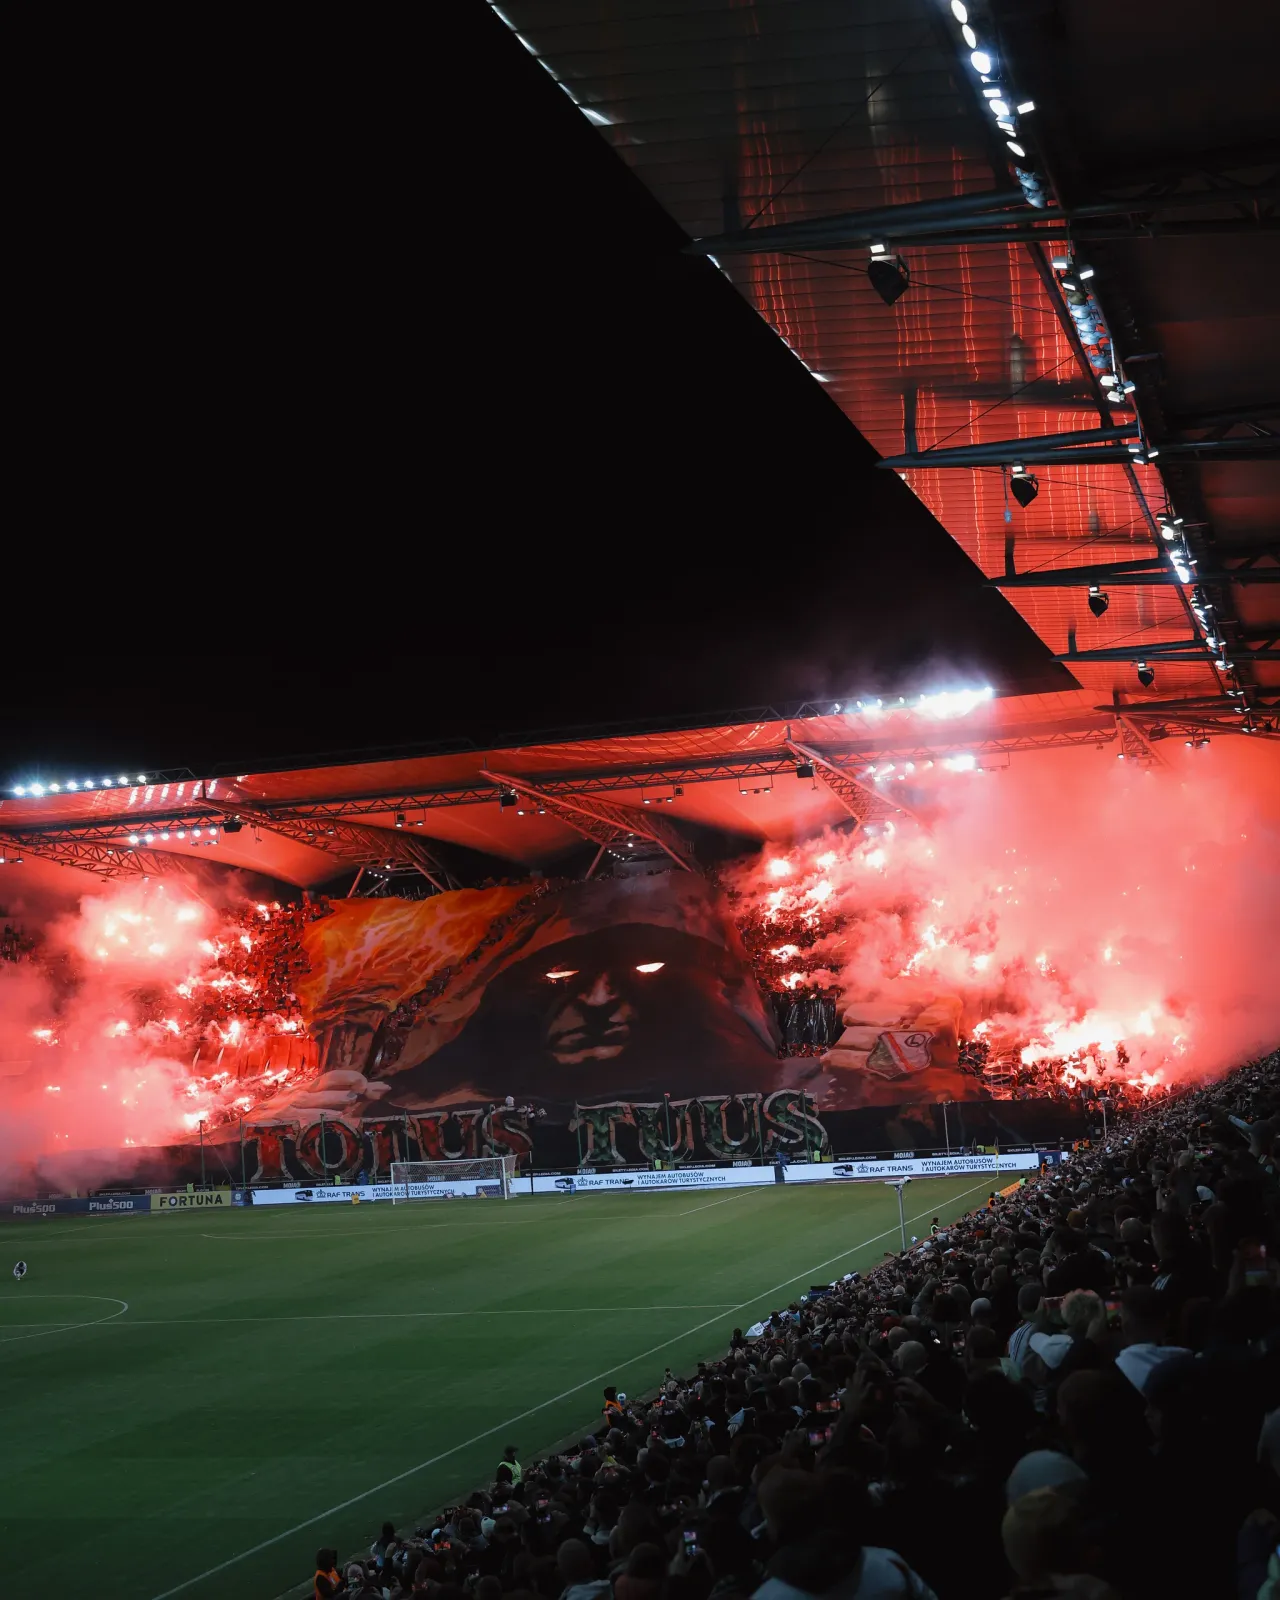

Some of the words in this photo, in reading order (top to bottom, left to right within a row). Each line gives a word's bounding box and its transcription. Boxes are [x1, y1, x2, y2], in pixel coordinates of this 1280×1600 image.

[242, 1105, 532, 1181] TOTUS
[568, 1088, 827, 1166] TUUS
[953, 1157, 993, 1165] AUTOBUSÓW
[925, 1164, 965, 1172] AUTOKARÓW
[966, 1162, 1017, 1170] TURYSTYCZNYCH
[667, 1171, 704, 1179] AUTOBUSÓW
[343, 1190, 366, 1198] TRANS
[159, 1194, 223, 1207] FORTUNA
[13, 1204, 56, 1214] Plus500
[89, 1201, 134, 1211] Plus500
